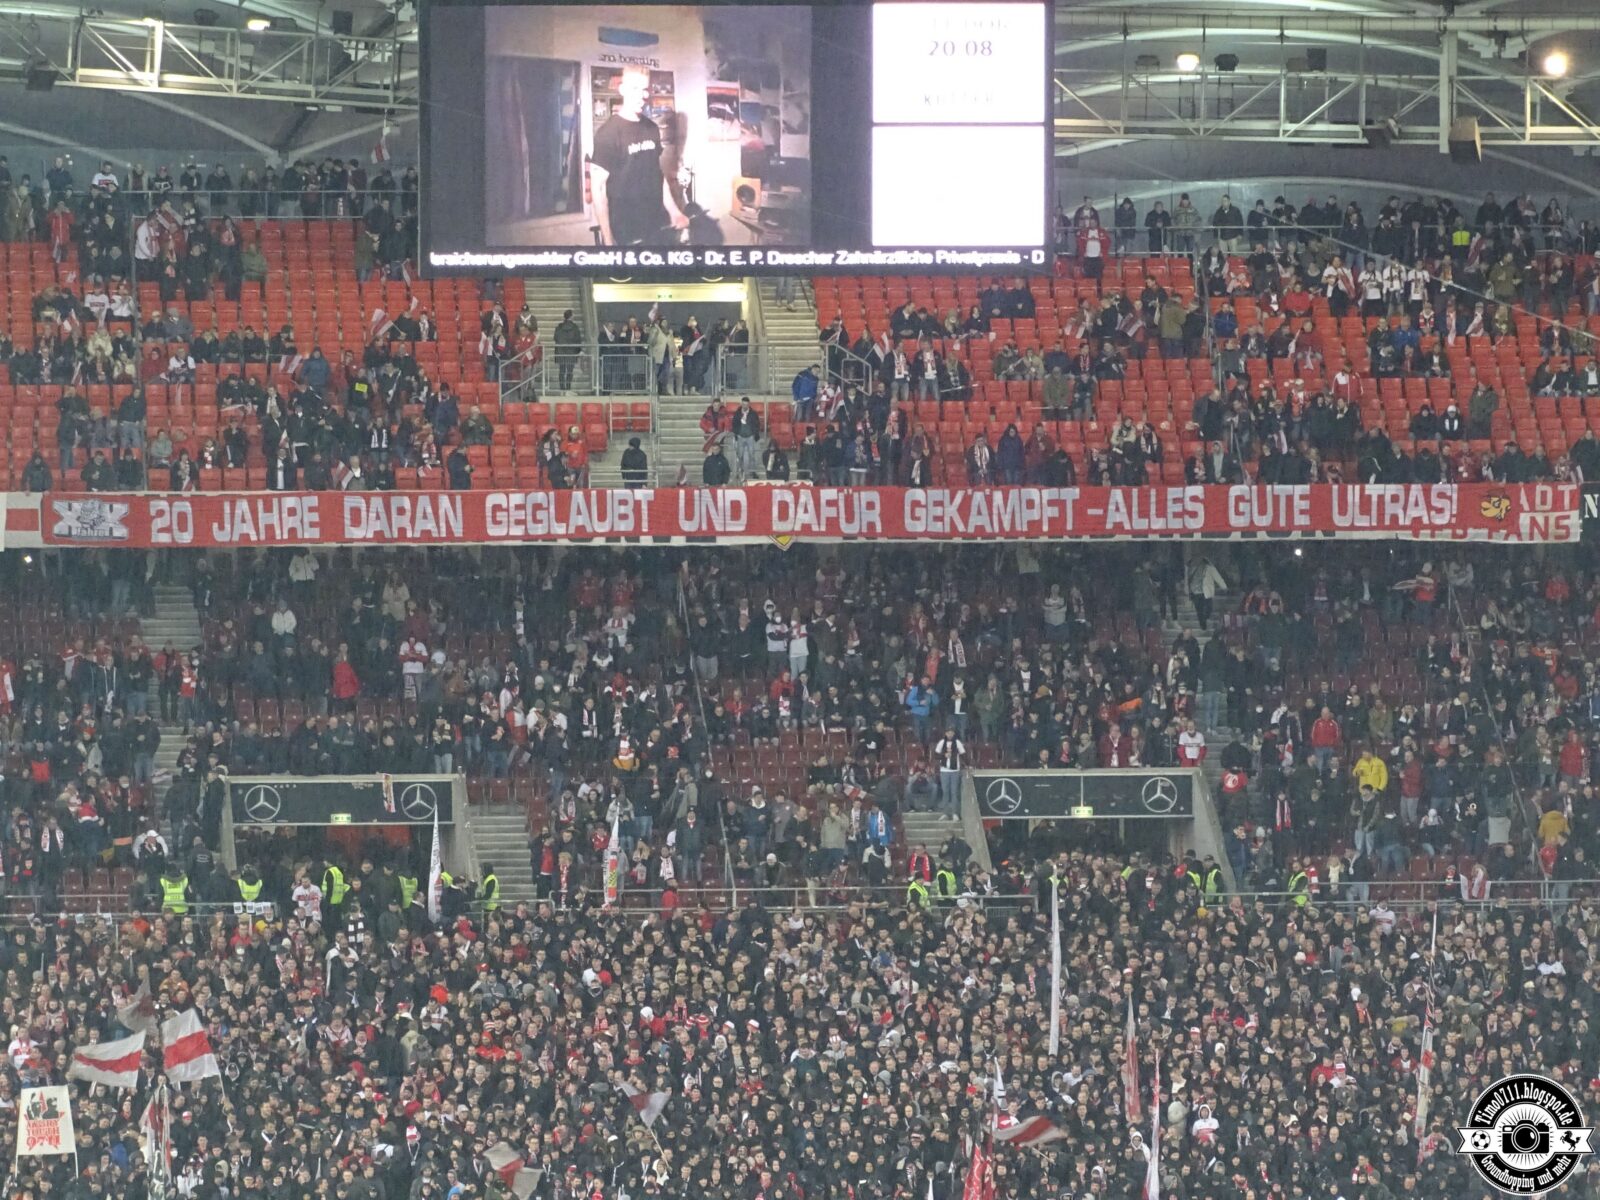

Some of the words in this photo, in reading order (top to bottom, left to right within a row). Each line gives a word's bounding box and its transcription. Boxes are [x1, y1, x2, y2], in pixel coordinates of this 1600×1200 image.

[574, 251, 622, 266] GmbH
[624, 251, 637, 266] &
[639, 251, 665, 266] Co.
[668, 251, 693, 266] KG
[705, 251, 726, 266] Dr.
[729, 251, 746, 266] E.
[750, 251, 764, 265] P.
[150, 500, 194, 543] 20
[212, 496, 320, 542] JAHRE
[343, 491, 463, 539] DARAN
[486, 489, 654, 535] GEGLAUBT
[678, 489, 748, 533] UND
[772, 488, 882, 534] DAFÜR
[904, 488, 1080, 533] GEKÄMPFT
[1229, 485, 1311, 529] GUTE
[1333, 484, 1458, 528] ULTRAS!
